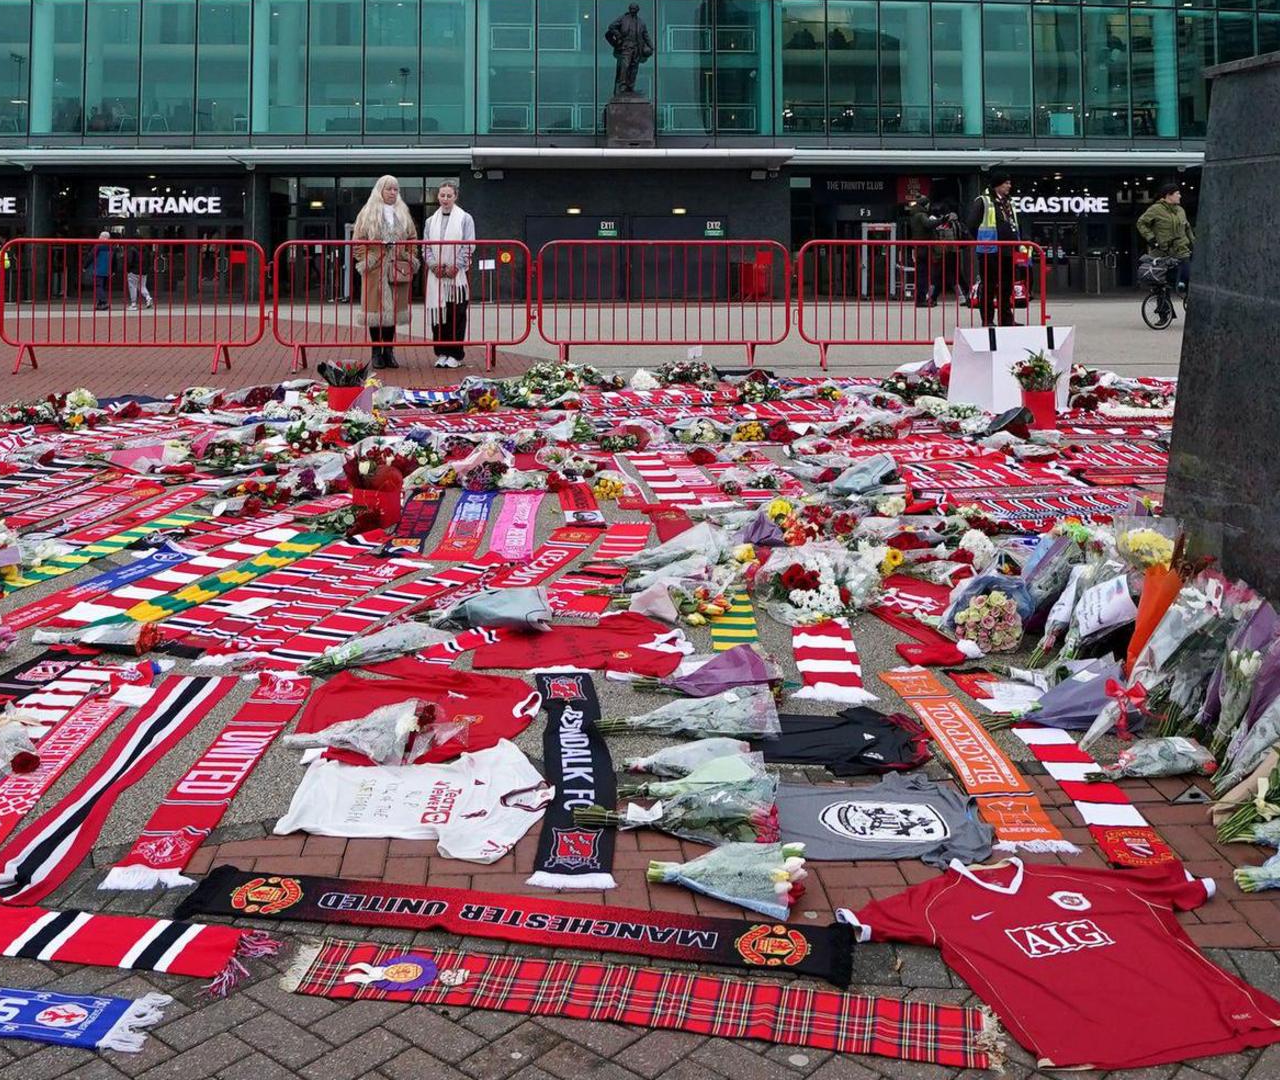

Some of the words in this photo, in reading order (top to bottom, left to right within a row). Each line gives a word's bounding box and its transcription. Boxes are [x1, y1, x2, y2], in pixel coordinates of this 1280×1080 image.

[108, 195, 221, 215] ENTRANCE
[1011, 196, 1110, 213] EGASTORE
[599, 221, 616, 231] EX11
[705, 221, 722, 231] EX12
[927, 702, 1005, 785] BLACKPOOL
[176, 729, 273, 795] UNITED
[318, 891, 449, 919] UNITED
[458, 901, 719, 950] MANCHESTER
[1021, 919, 1108, 954] AIG
